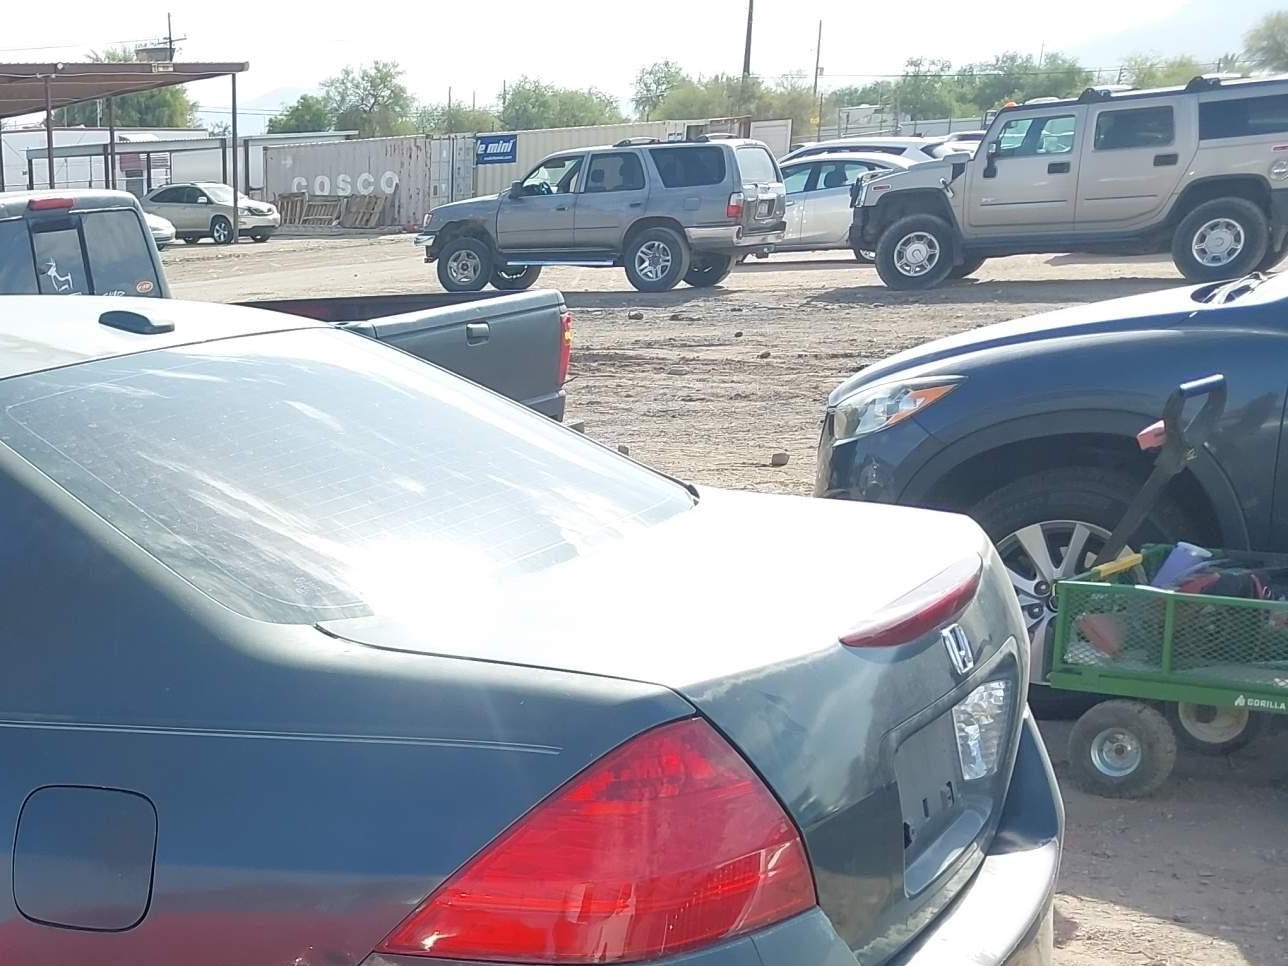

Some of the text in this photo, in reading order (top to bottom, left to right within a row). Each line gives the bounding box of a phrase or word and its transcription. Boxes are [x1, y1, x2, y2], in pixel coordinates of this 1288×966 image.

[487, 139, 514, 154] mini
[292, 170, 399, 196] COSCO
[1247, 698, 1286, 710] GORILLA
